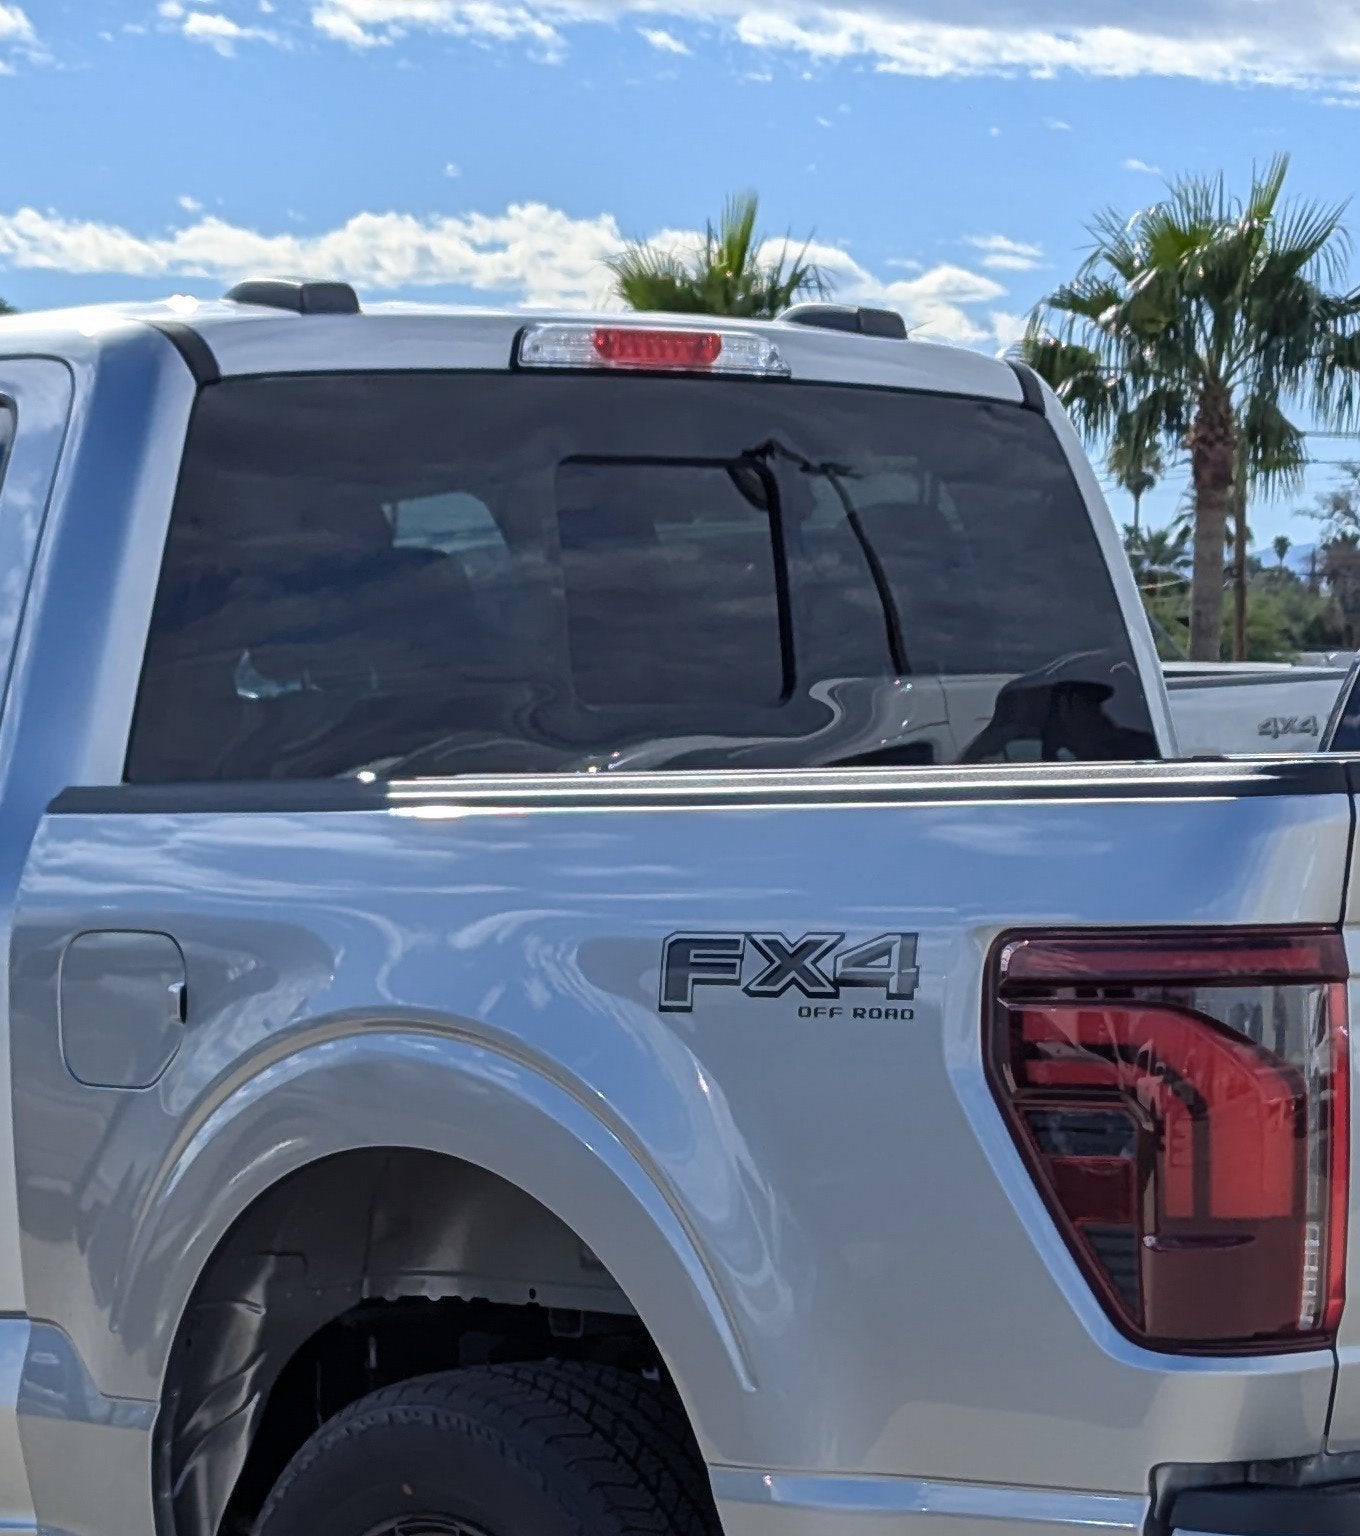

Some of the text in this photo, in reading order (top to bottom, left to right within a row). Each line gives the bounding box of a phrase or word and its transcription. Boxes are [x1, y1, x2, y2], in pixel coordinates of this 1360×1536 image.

[658, 930, 920, 1013] FX4
[797, 1005, 915, 1021] OFF ROAD
